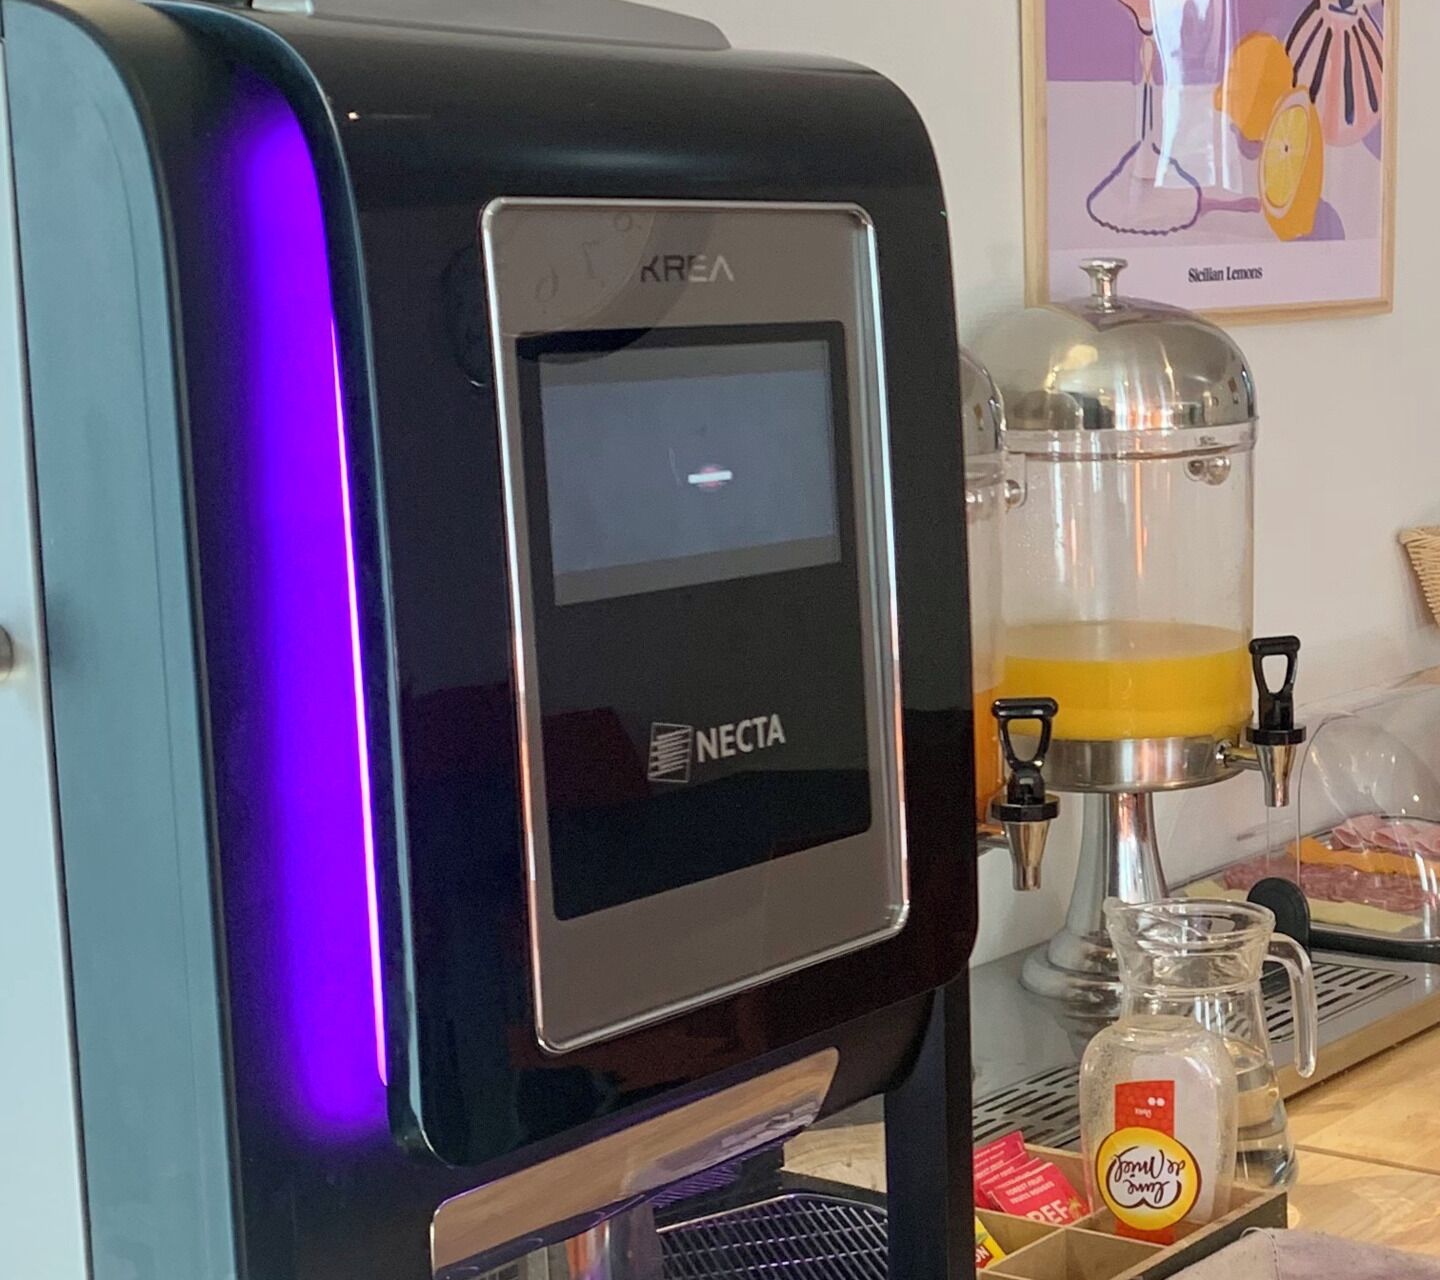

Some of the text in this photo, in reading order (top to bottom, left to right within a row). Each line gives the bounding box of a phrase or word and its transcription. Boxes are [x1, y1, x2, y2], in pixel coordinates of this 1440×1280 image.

[639, 254, 735, 282] KREA
[1188, 266, 1263, 283] Sicilian Lemons
[695, 713, 786, 763] NECTA
[1166, 1158, 1186, 1177] de
